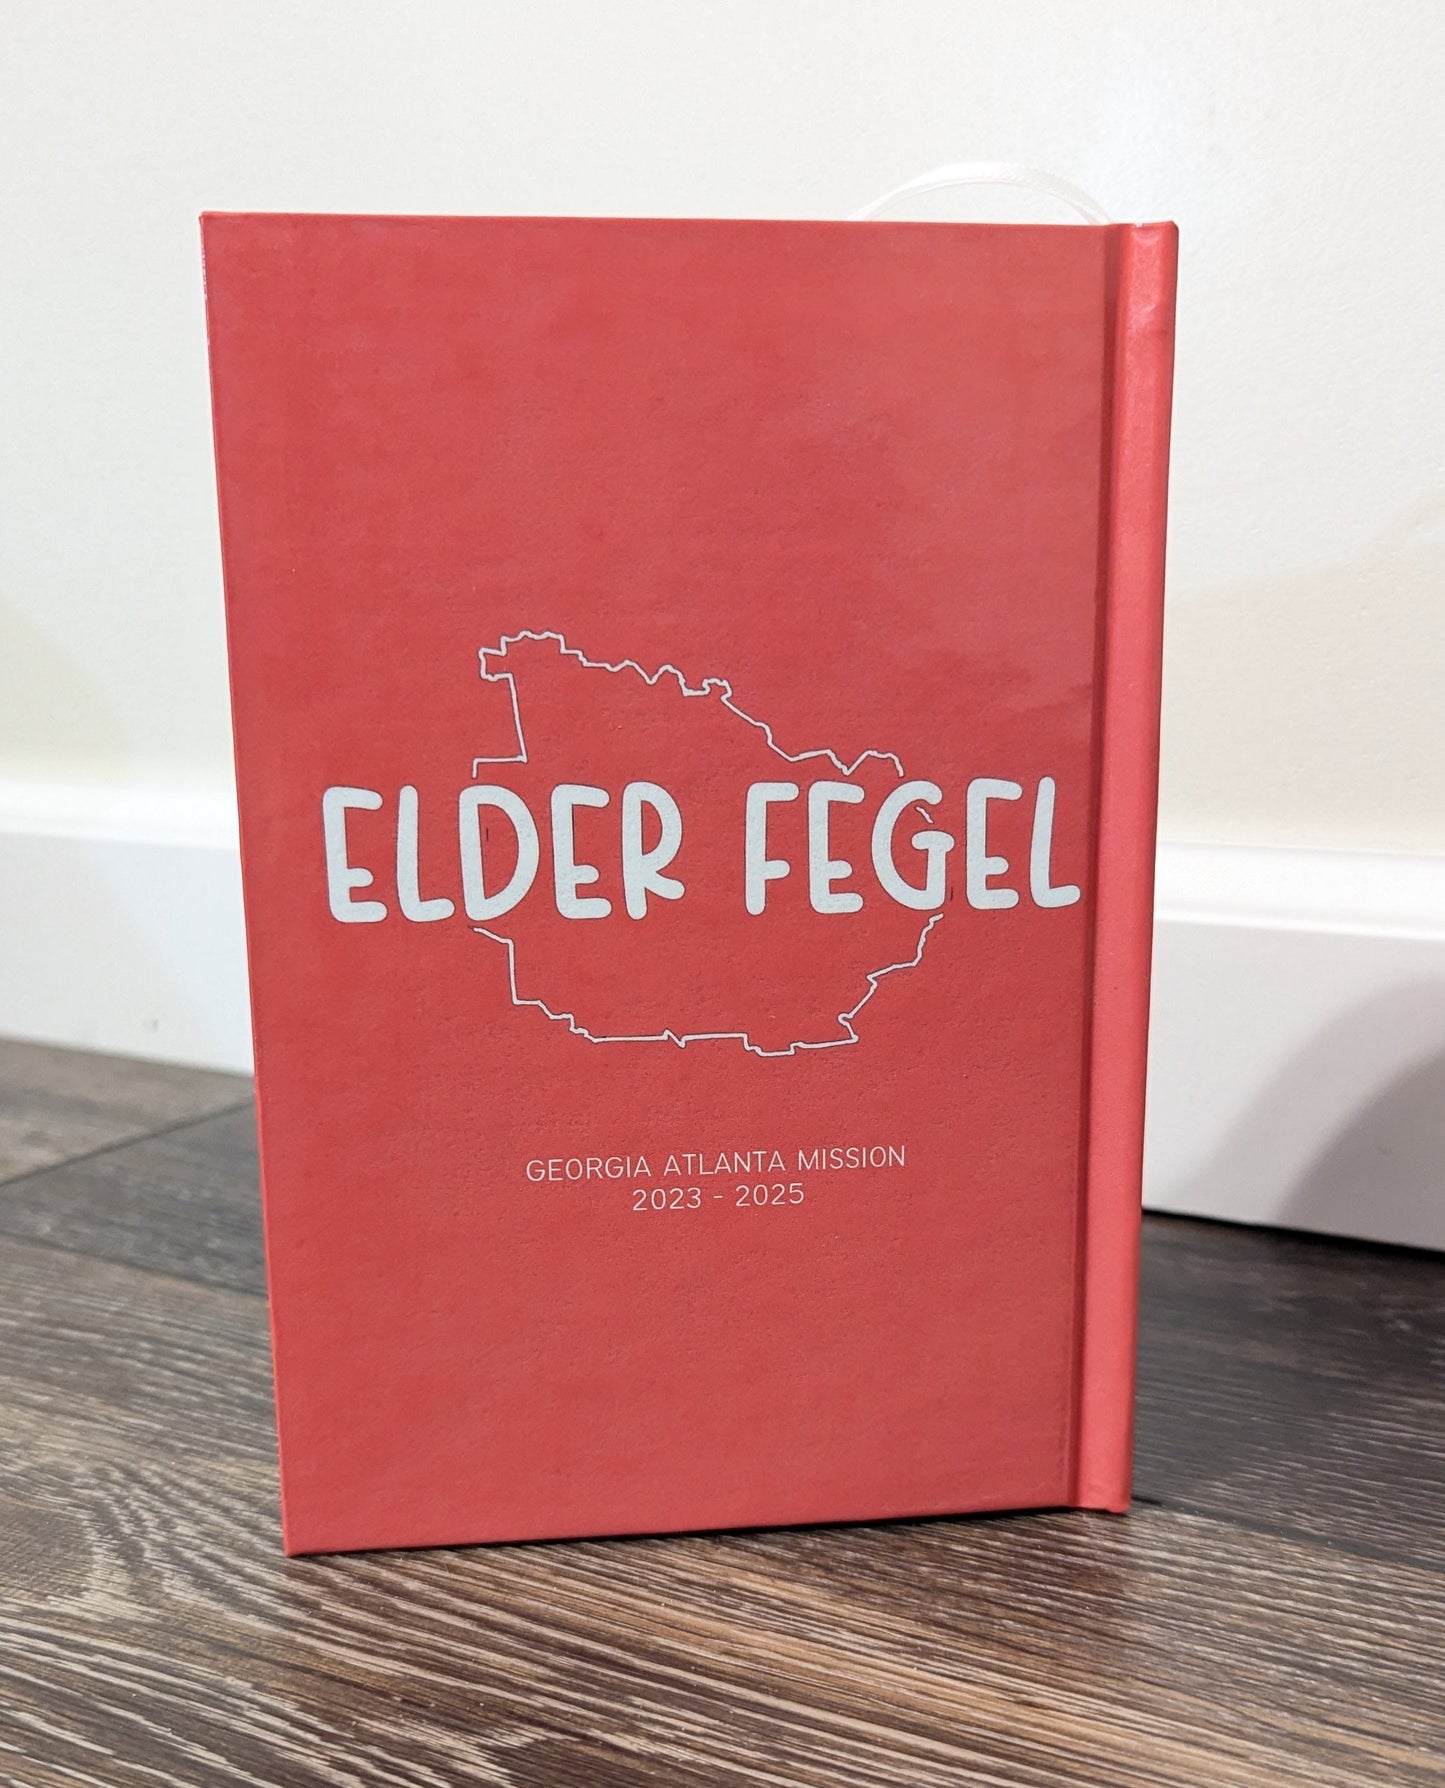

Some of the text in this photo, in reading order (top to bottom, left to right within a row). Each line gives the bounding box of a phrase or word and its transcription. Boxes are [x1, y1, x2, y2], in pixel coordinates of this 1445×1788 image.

[322, 776, 1081, 923] ELDER FEGEL
[526, 1145, 906, 1182] GEORGIA ATLANTA MISSION
[632, 1187, 702, 1211] 2023
[735, 1182, 805, 1207] 2025
